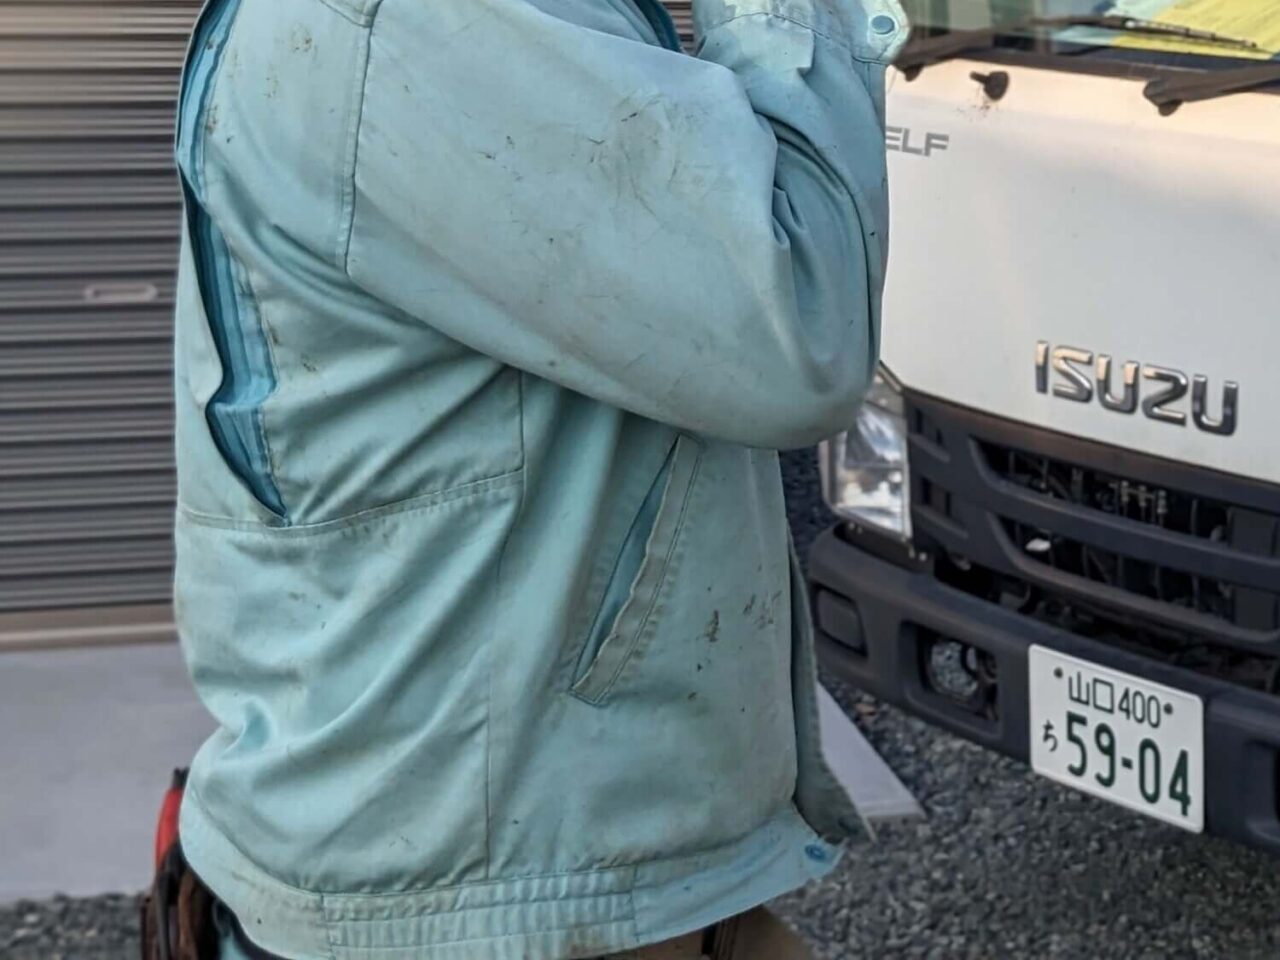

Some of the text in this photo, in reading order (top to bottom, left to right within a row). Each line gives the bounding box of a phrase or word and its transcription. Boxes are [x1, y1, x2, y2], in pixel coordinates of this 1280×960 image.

[885, 126, 949, 157] ELF
[1035, 339, 1239, 437] ISUZU
[1042, 711, 1191, 817] ち 59-04
